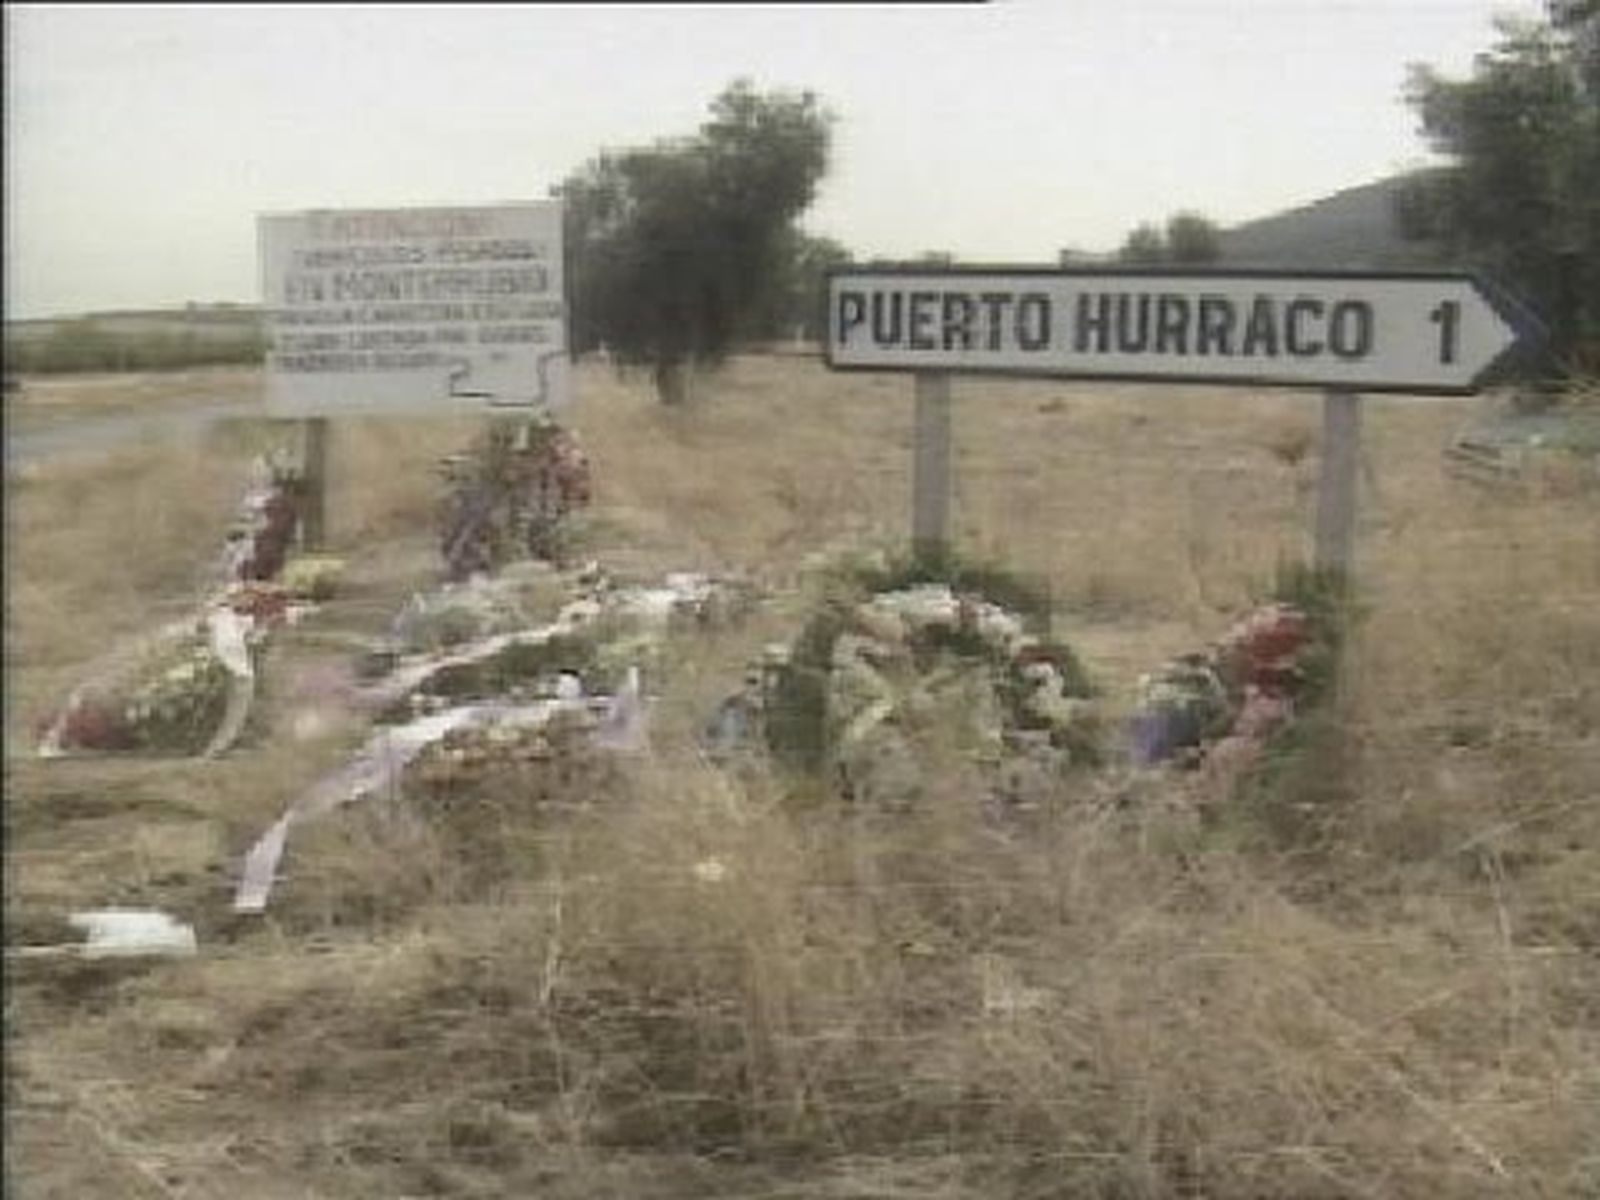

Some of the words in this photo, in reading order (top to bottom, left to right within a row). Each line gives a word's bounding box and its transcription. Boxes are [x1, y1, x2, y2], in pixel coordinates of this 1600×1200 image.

[838, 292, 1052, 352] PUERTO
[1074, 292, 1375, 361] HURRACO
[1429, 300, 1461, 365] 1
